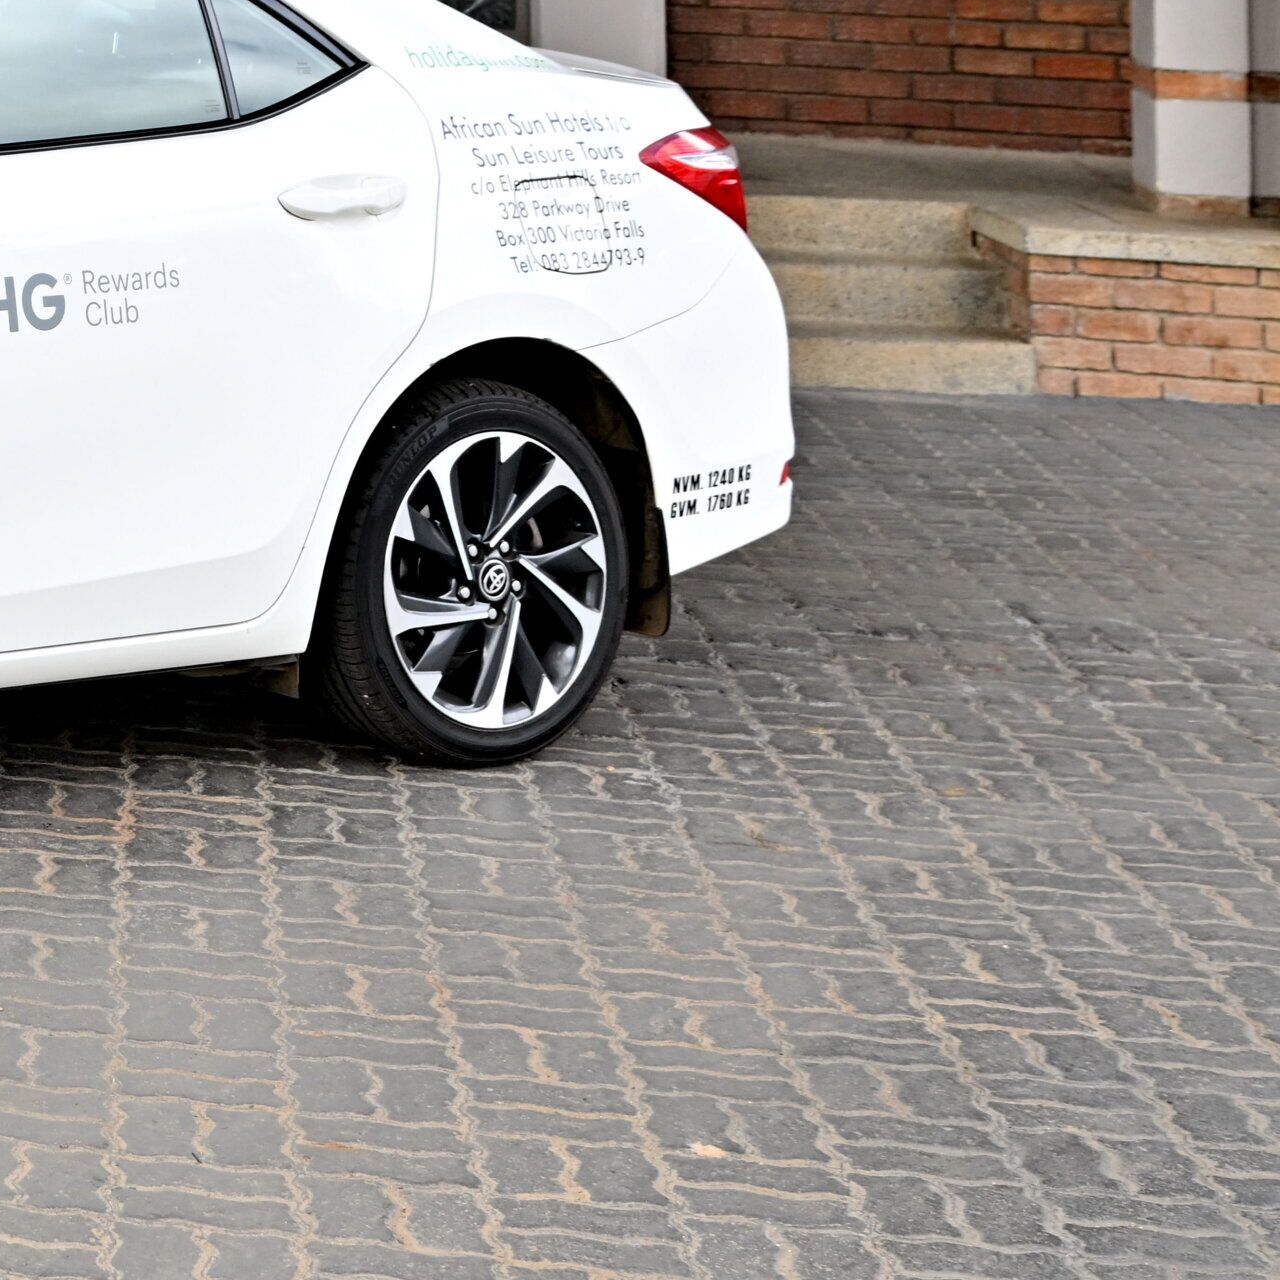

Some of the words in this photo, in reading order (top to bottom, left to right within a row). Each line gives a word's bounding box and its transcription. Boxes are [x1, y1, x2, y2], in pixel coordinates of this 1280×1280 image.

[440, 116, 507, 140] African
[508, 113, 546, 136] Sun
[546, 109, 604, 133] Hotels
[471, 147, 509, 168] Sun
[511, 145, 576, 166] Leisure
[576, 141, 624, 161] Tours
[471, 178, 496, 196] c/o
[600, 167, 642, 186] Resort
[499, 200, 529, 220] 328
[532, 198, 591, 219] Parkway
[594, 195, 631, 213] Drive
[496, 229, 525, 247] Box
[527, 225, 556, 244] 300
[557, 223, 611, 242] Victoria
[614, 219, 645, 238] Falls
[510, 255, 538, 274] Tel:
[81, 262, 180, 295] Rewards
[85, 298, 140, 327] Club
[708, 468, 735, 489] 1240
[737, 464, 752, 482] KG
[707, 492, 733, 513] 1760
[736, 488, 751, 506] KG
